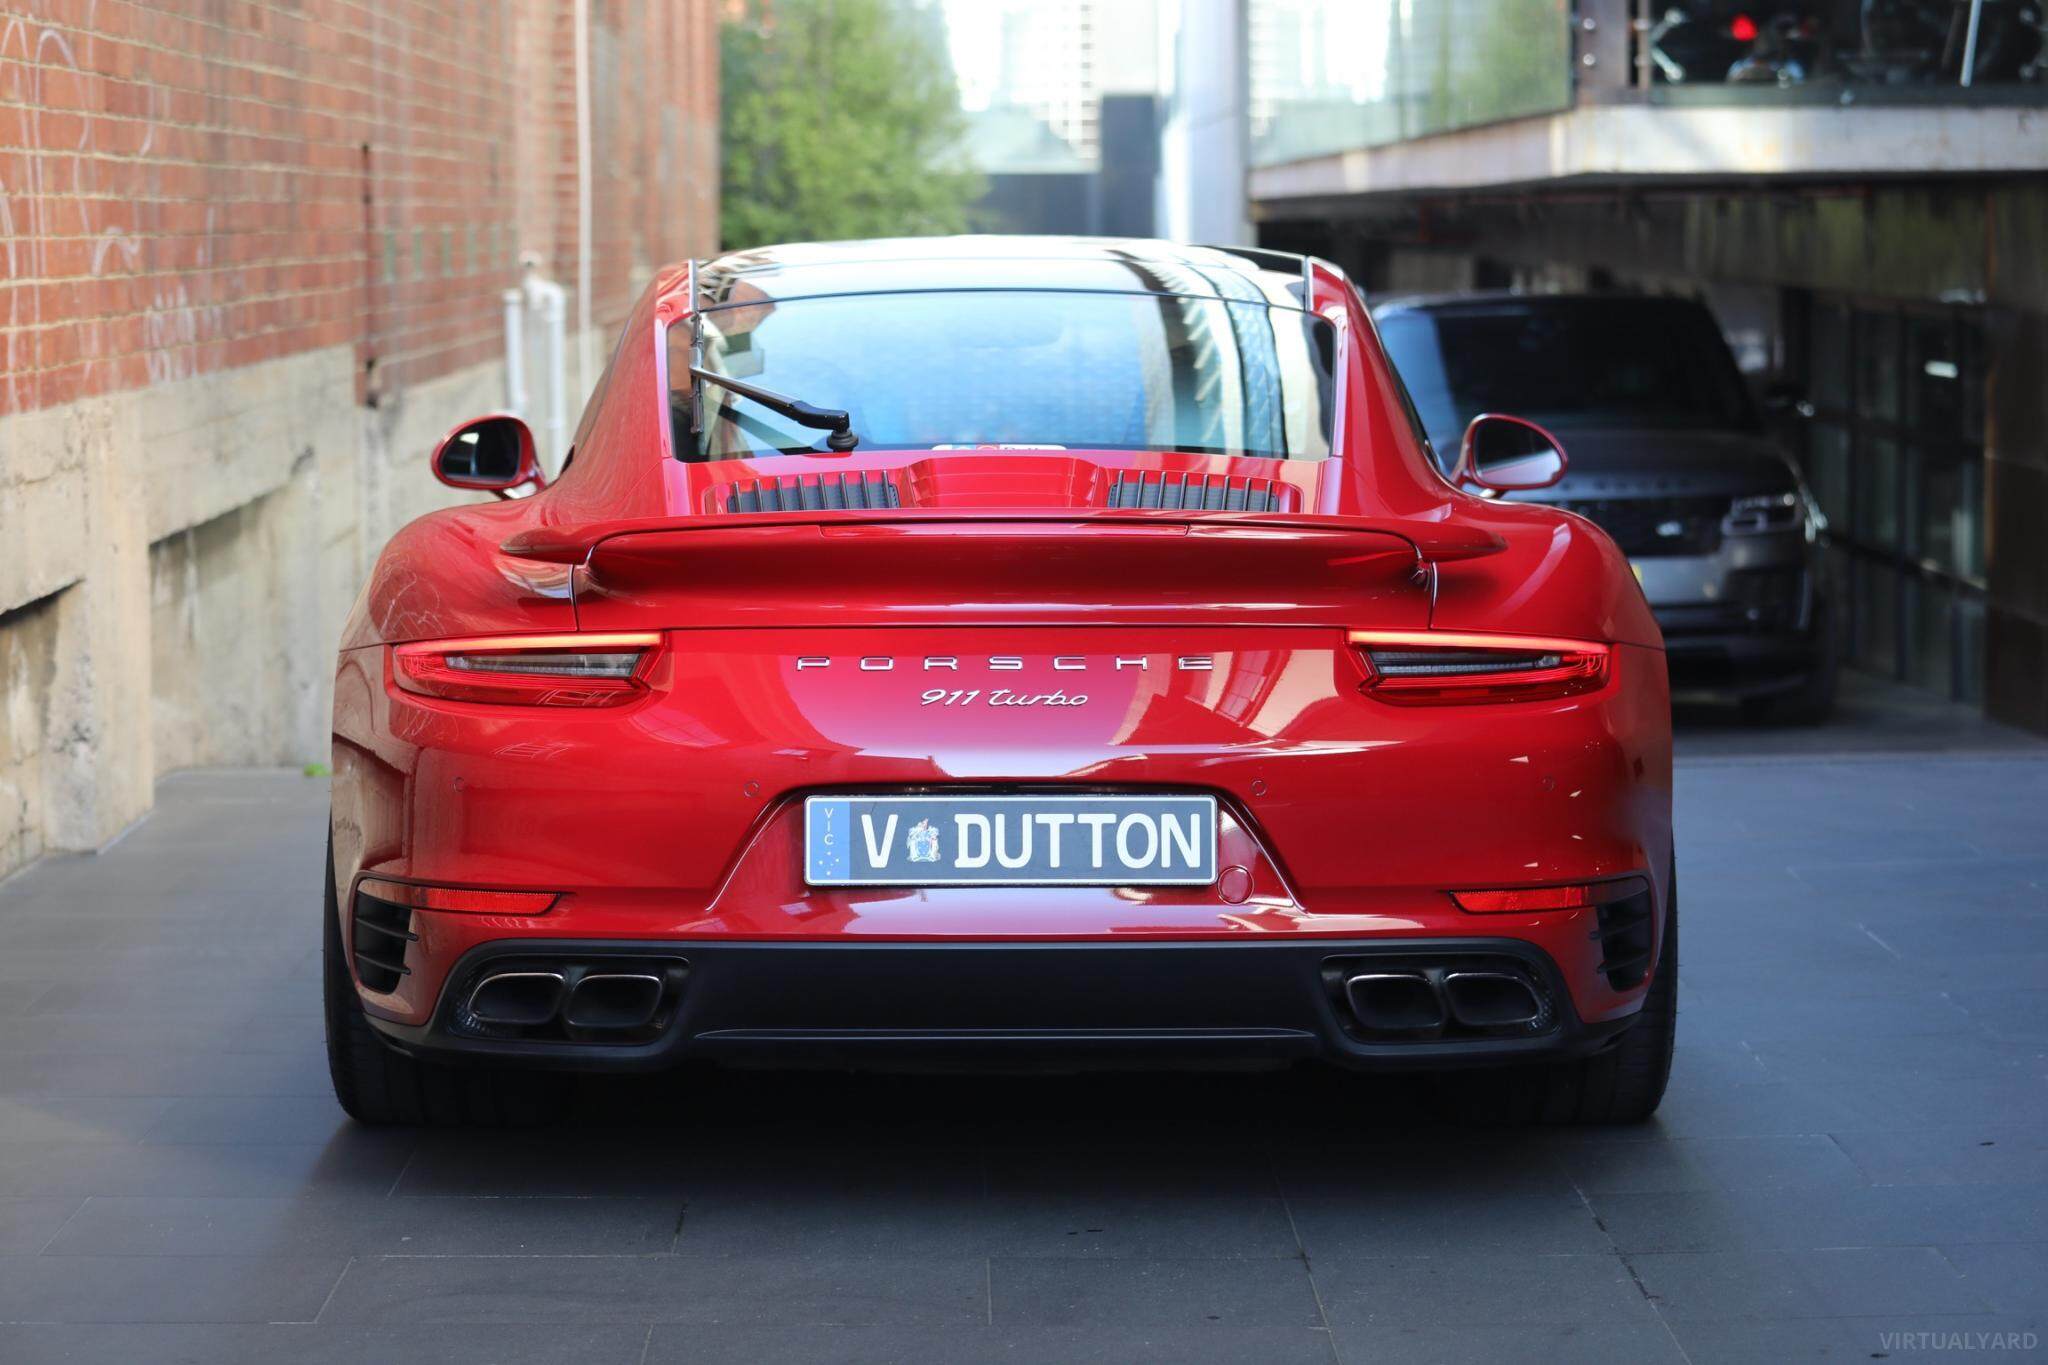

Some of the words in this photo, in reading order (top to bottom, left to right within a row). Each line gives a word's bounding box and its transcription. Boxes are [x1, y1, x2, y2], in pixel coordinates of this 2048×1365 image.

[797, 656, 1213, 671] PORSCHE
[920, 688, 981, 706] 911
[988, 688, 1089, 707] turbo
[824, 807, 834, 846] VIC
[861, 813, 899, 868] V
[954, 813, 1200, 868] DUTTON
